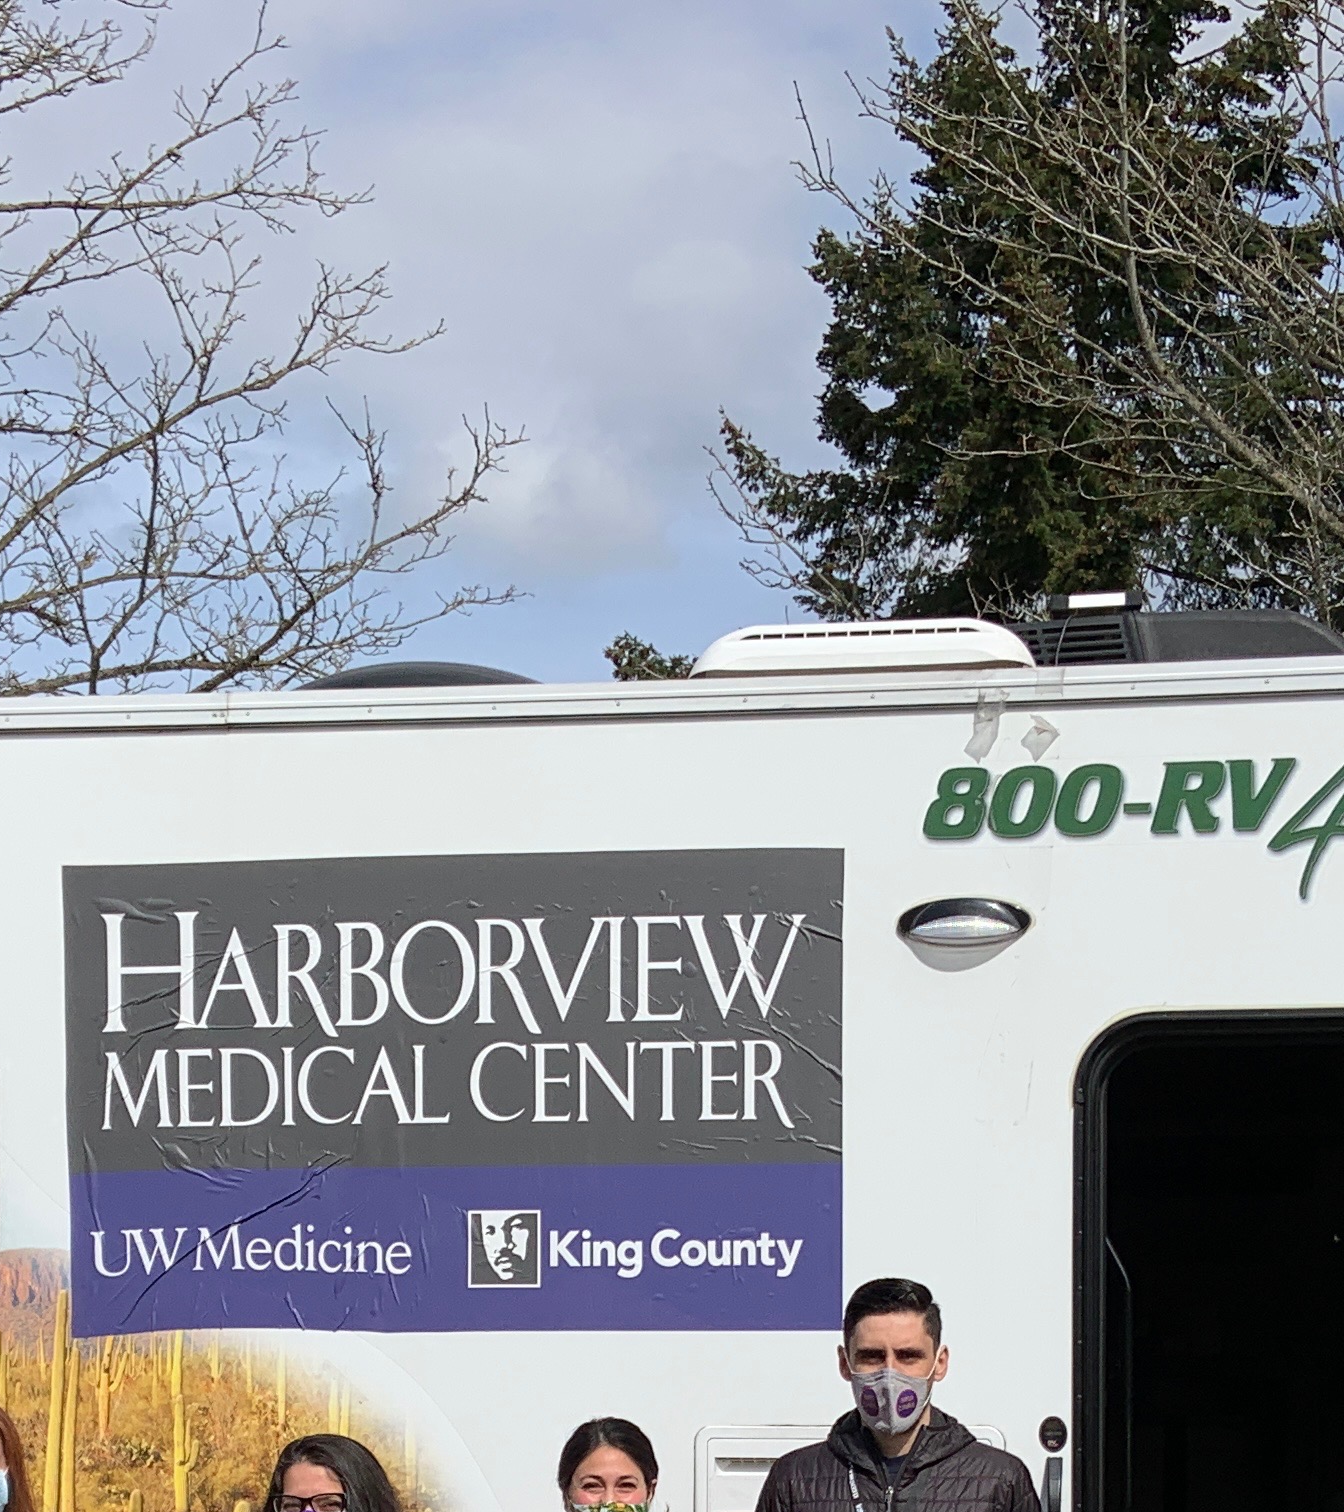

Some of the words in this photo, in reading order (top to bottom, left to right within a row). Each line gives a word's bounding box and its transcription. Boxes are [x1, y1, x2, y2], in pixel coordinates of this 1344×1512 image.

[100, 911, 806, 1037] HARBORVIEW
[101, 1045, 450, 1130] MEDICAL
[469, 1038, 795, 1129] CENTER
[90, 1227, 188, 1278] UW
[191, 1222, 412, 1276] Medicine
[548, 1230, 644, 1278] King
[650, 1229, 803, 1278] County
